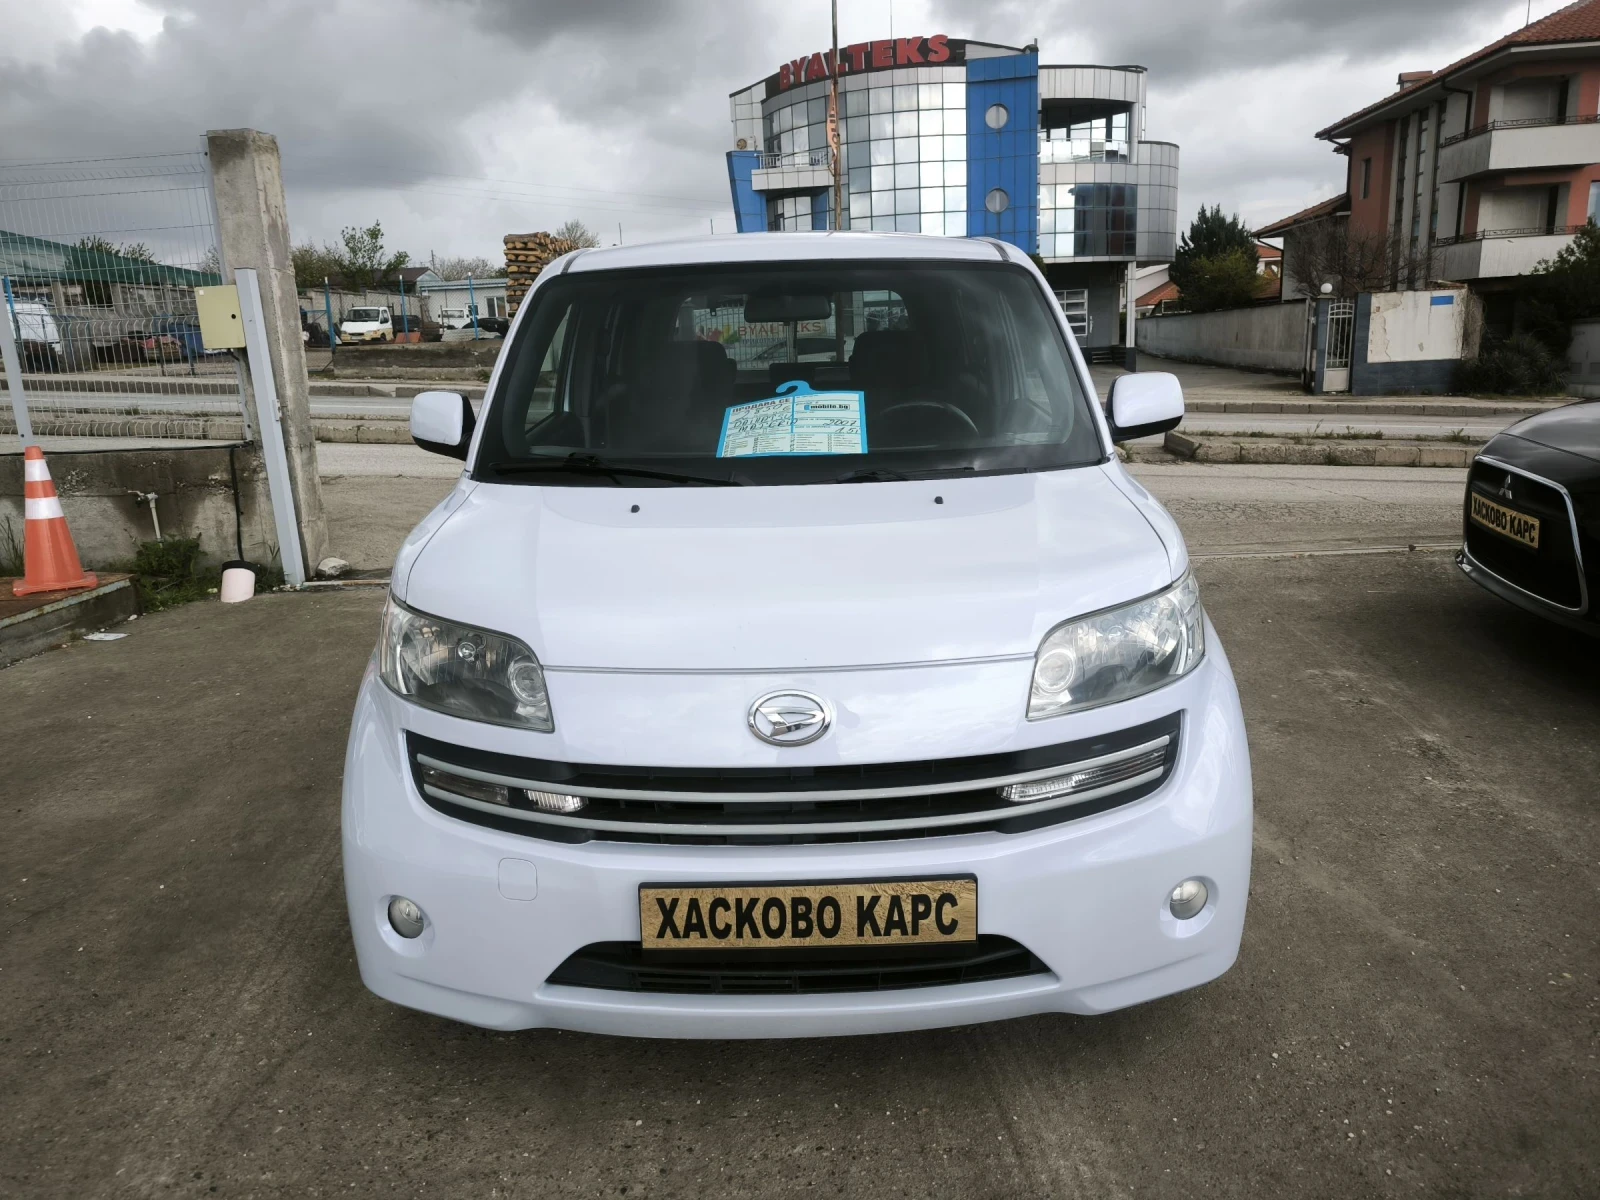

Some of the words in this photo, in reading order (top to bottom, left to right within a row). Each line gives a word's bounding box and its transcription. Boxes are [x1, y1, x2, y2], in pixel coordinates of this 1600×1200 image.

[780, 34, 950, 90] BYALTEKS
[1473, 495, 1507, 531] ХАСКОВО
[1510, 515, 1536, 544] КАРС
[655, 895, 842, 940] ХАСКОВО
[857, 892, 959, 938] КАРС
